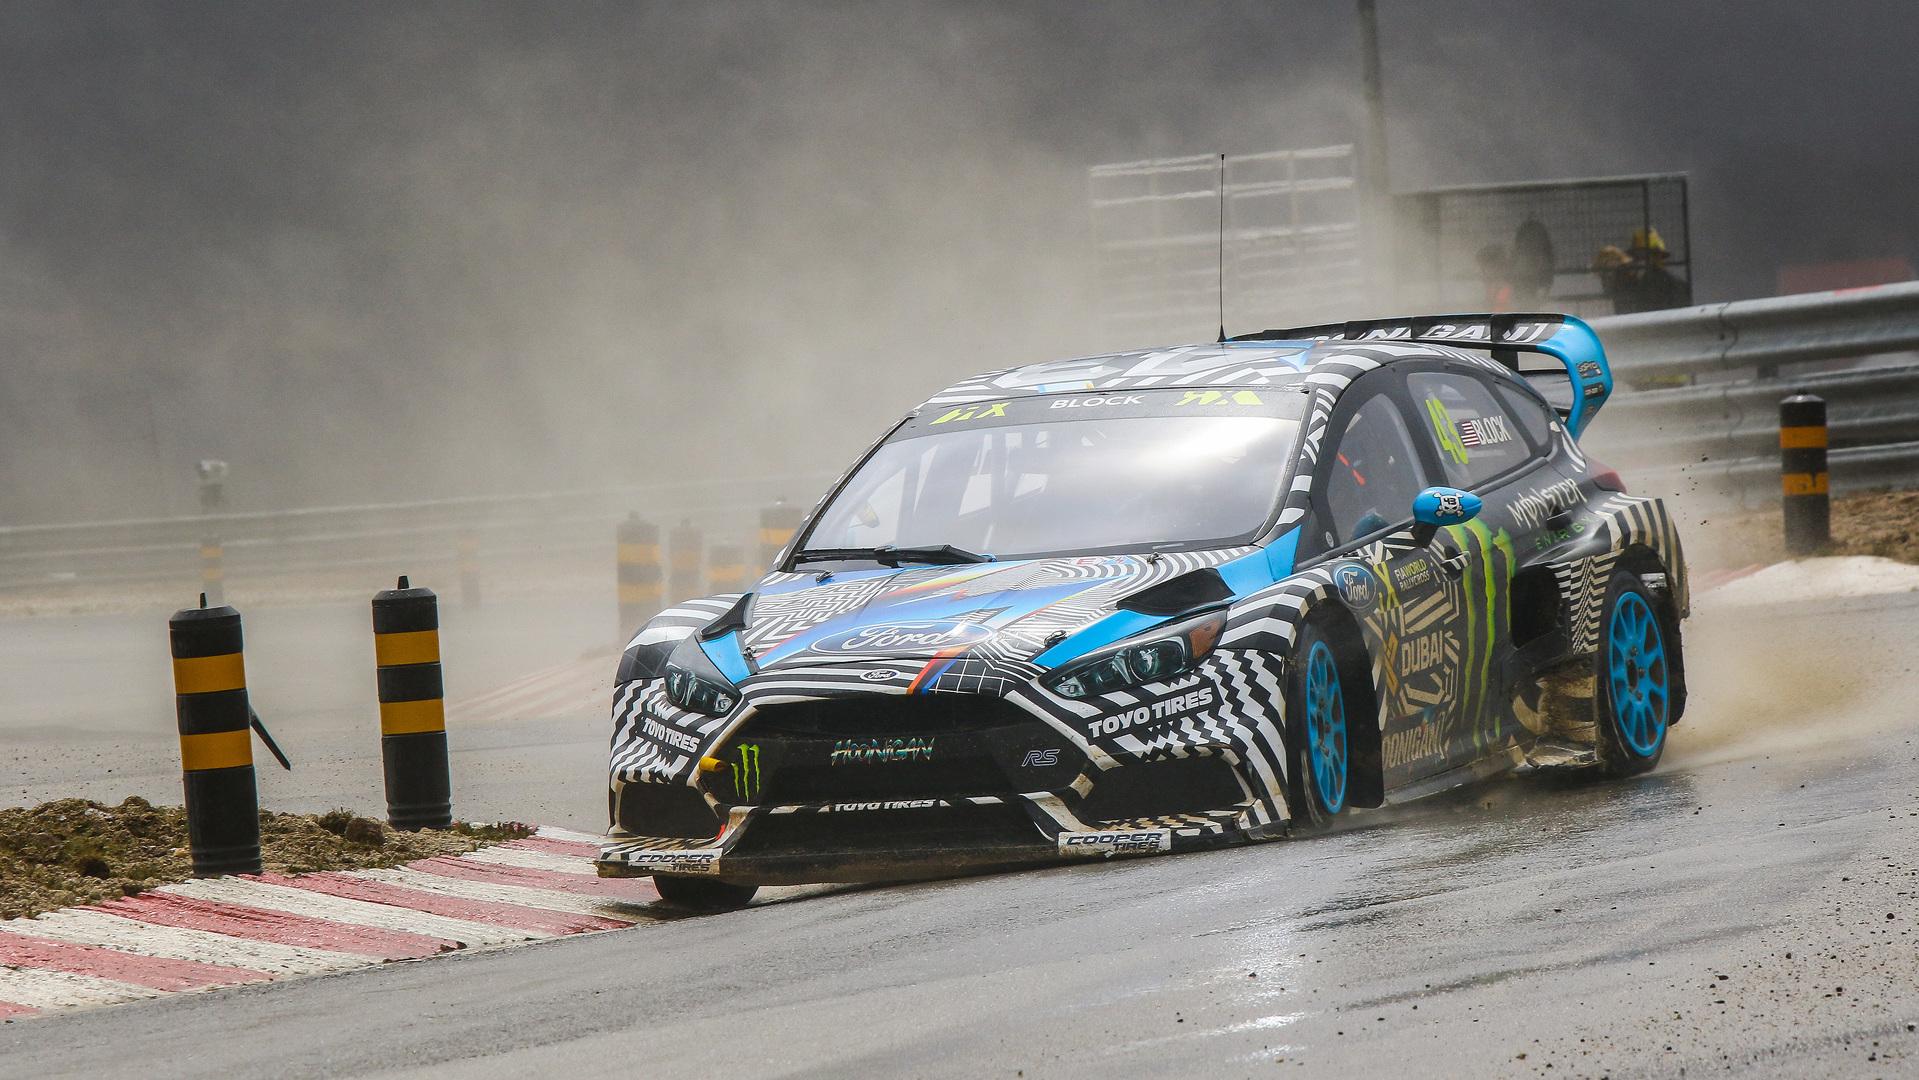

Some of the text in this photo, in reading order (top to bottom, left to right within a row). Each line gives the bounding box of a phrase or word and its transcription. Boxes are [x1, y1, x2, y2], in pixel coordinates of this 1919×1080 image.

[1050, 395, 1145, 409] BLOCK
[1425, 395, 1469, 465] 43
[1470, 415, 1512, 445] BLOCK
[1443, 497, 1457, 505] 43
[1342, 571, 1370, 602] Ford
[841, 619, 966, 650] Ford
[1401, 630, 1443, 678] DUBAI
[867, 669, 892, 680] Ford
[1088, 687, 1213, 738] TOYO TIRES
[643, 717, 700, 753] TOYO TIRES
[1021, 748, 1061, 767] RS
[835, 799, 936, 812] TOYO TIRES
[1066, 832, 1163, 846] COOPER
[1112, 841, 1161, 851] TIRES
[635, 853, 715, 864] COOPER
[671, 863, 711, 872] TIRES
